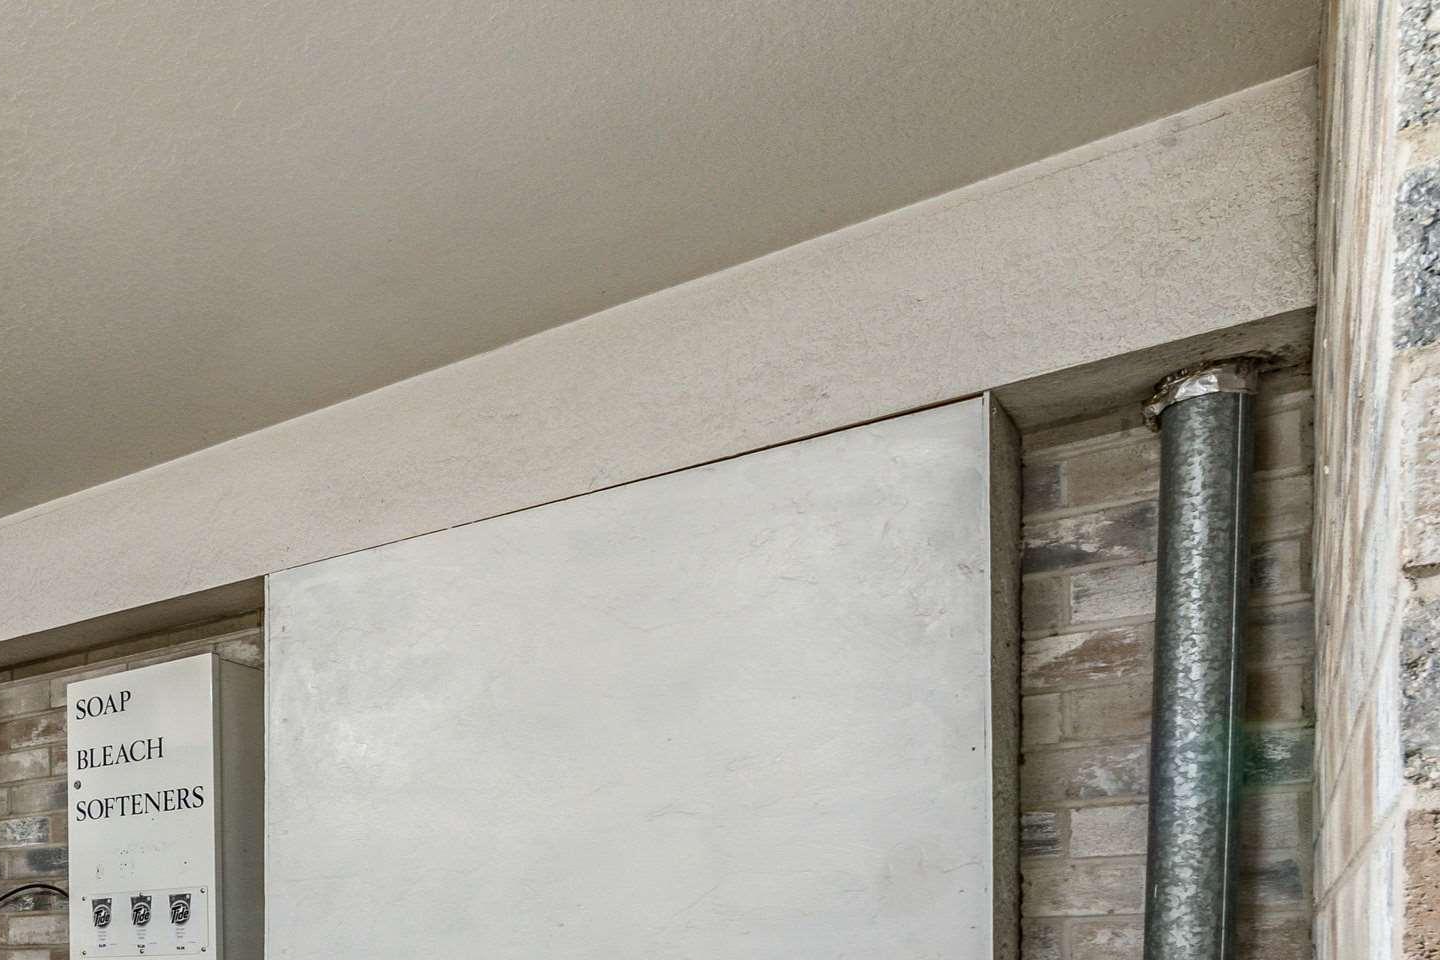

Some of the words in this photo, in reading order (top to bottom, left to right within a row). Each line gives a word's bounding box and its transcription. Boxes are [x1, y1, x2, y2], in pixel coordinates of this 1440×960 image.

[75, 690, 131, 720] SOAP
[76, 737, 164, 770] BLEACH
[75, 785, 204, 821] SOFTENERS
[94, 909, 111, 927] Tide
[132, 906, 150, 925] Tide
[170, 904, 189, 924] Tide
